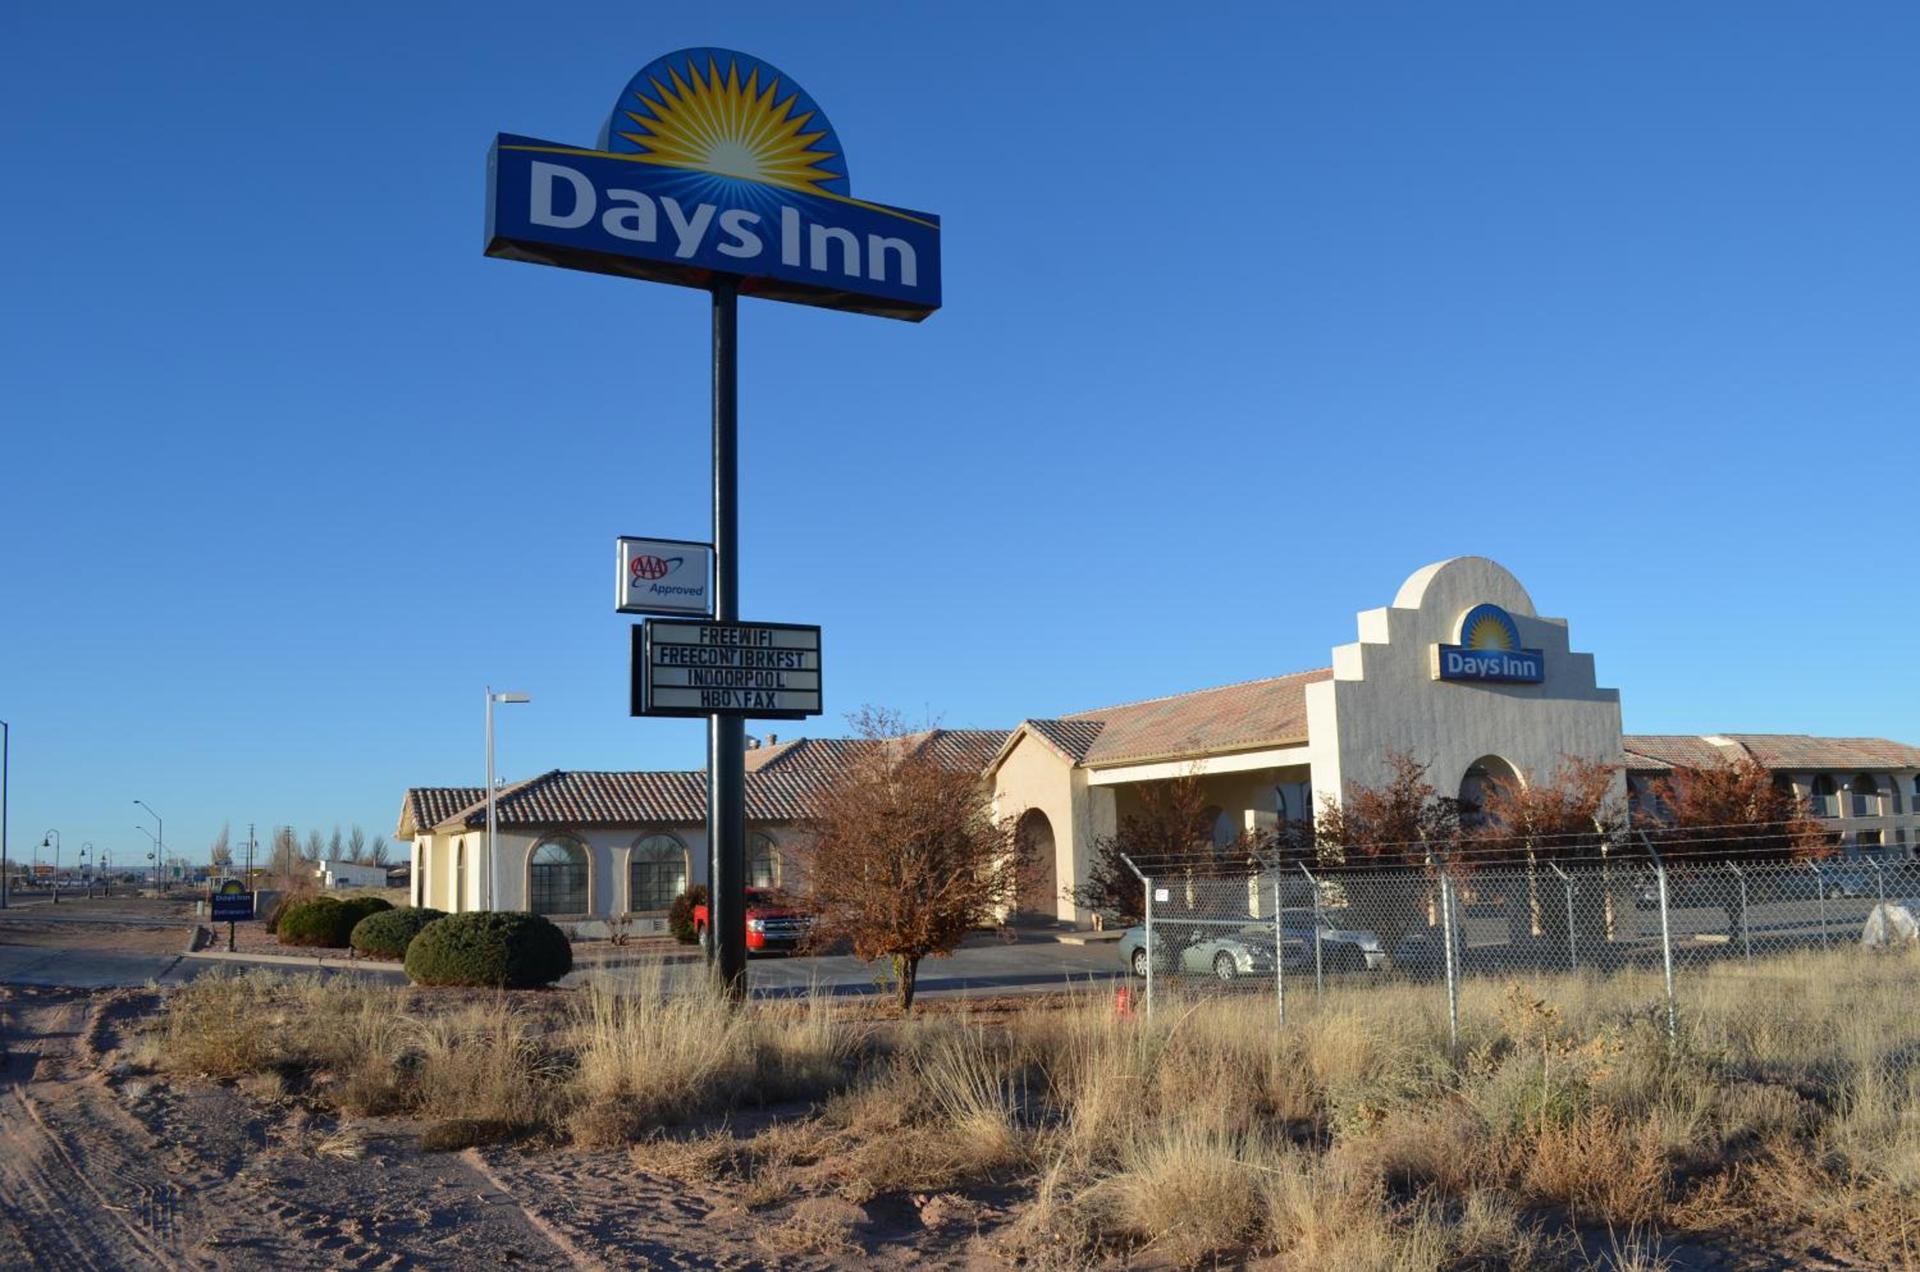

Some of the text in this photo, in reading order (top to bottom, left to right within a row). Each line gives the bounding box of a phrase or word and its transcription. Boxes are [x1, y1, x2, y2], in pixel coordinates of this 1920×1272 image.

[530, 160, 918, 287] Days Inn
[633, 556, 668, 579] AAA
[650, 582, 704, 597] Approved
[1447, 652, 1536, 678] Days Inn
